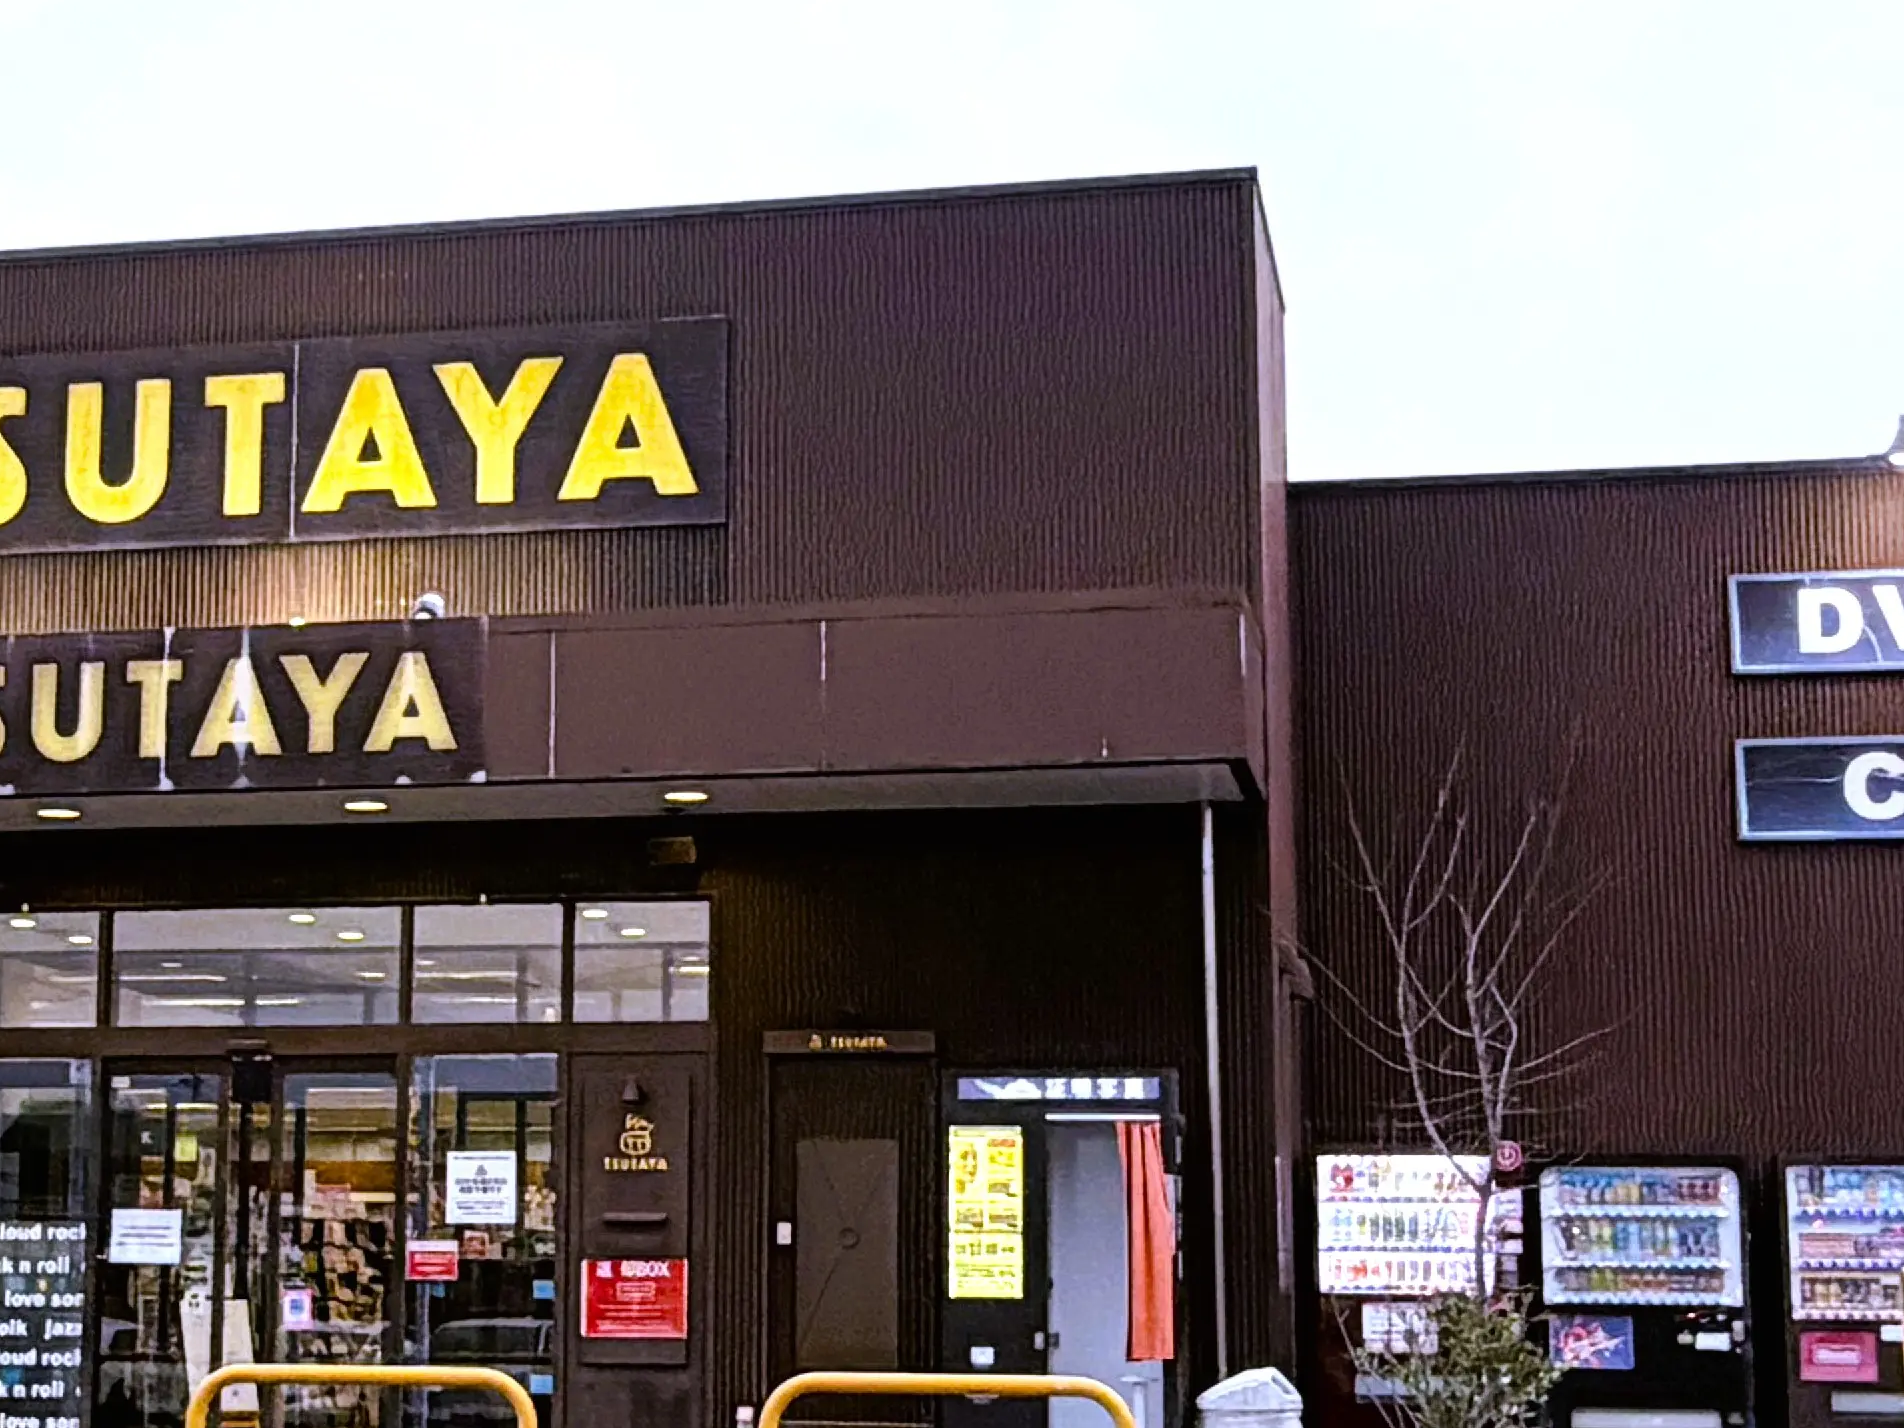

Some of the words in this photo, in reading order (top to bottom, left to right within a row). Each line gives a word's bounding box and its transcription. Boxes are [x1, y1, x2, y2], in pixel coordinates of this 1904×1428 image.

[0, 1222, 42, 1241] loud
[37, 1256, 70, 1274] roll
[4, 1289, 46, 1308] love
[31, 1380, 64, 1398] roll
